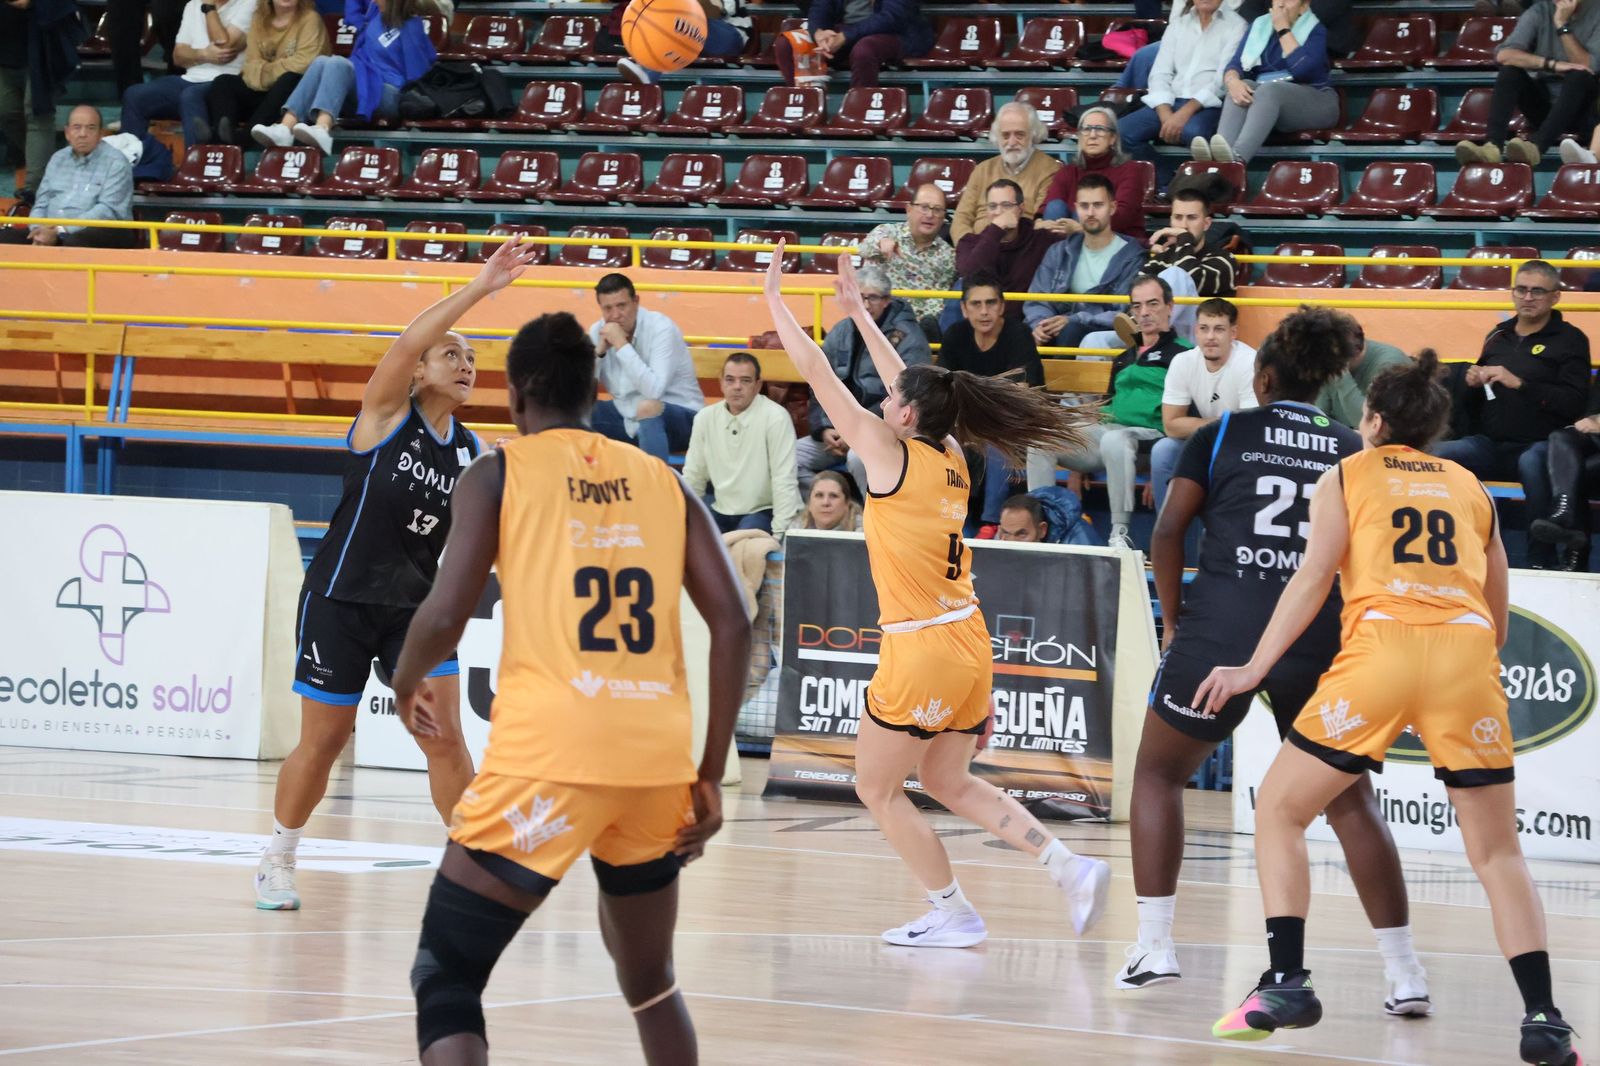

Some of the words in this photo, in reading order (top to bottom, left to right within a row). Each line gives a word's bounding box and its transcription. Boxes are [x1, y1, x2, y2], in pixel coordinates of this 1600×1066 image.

[489, 22, 506, 33] 20
[966, 25, 977, 40] 8
[1050, 25, 1062, 40] 6
[1397, 23, 1409, 38] 3
[1490, 25, 1503, 41] 5
[547, 84, 565, 101] 16
[625, 90, 640, 102] 14
[706, 92, 722, 104] 12
[872, 93, 883, 108] 8
[955, 94, 967, 109] 6
[1041, 95, 1051, 107] 4
[1398, 95, 1411, 110] 5
[207, 152, 224, 163] 22
[284, 151, 306, 167] 20
[441, 152, 458, 169] 16
[522, 158, 537, 170] 14
[603, 160, 619, 172] 12
[686, 160, 703, 173] 10
[769, 162, 782, 177] 8
[854, 164, 867, 179] 6
[1300, 168, 1312, 184] 5
[1393, 169, 1407, 186] 7
[1490, 168, 1504, 185] 9
[1583, 169, 1600, 184] 11
[1264, 426, 1339, 455] LALOTTE
[1242, 452, 1332, 472] GIPUZKOAKIRO
[1383, 456, 1446, 473] SÁNCHEZ
[407, 508, 440, 536] 13
[1392, 506, 1458, 566] 28
[945, 532, 964, 581] 9
[1236, 546, 1304, 570] DOM
[573, 565, 655, 655] 23
[0, 667, 138, 710] ecoletas
[152, 674, 233, 714] salud
[992, 686, 1088, 740] SUEÑA
[798, 715, 832, 732] SIN
[794, 770, 849, 783] TENEMOS
[1007, 789, 1024, 798] DE
